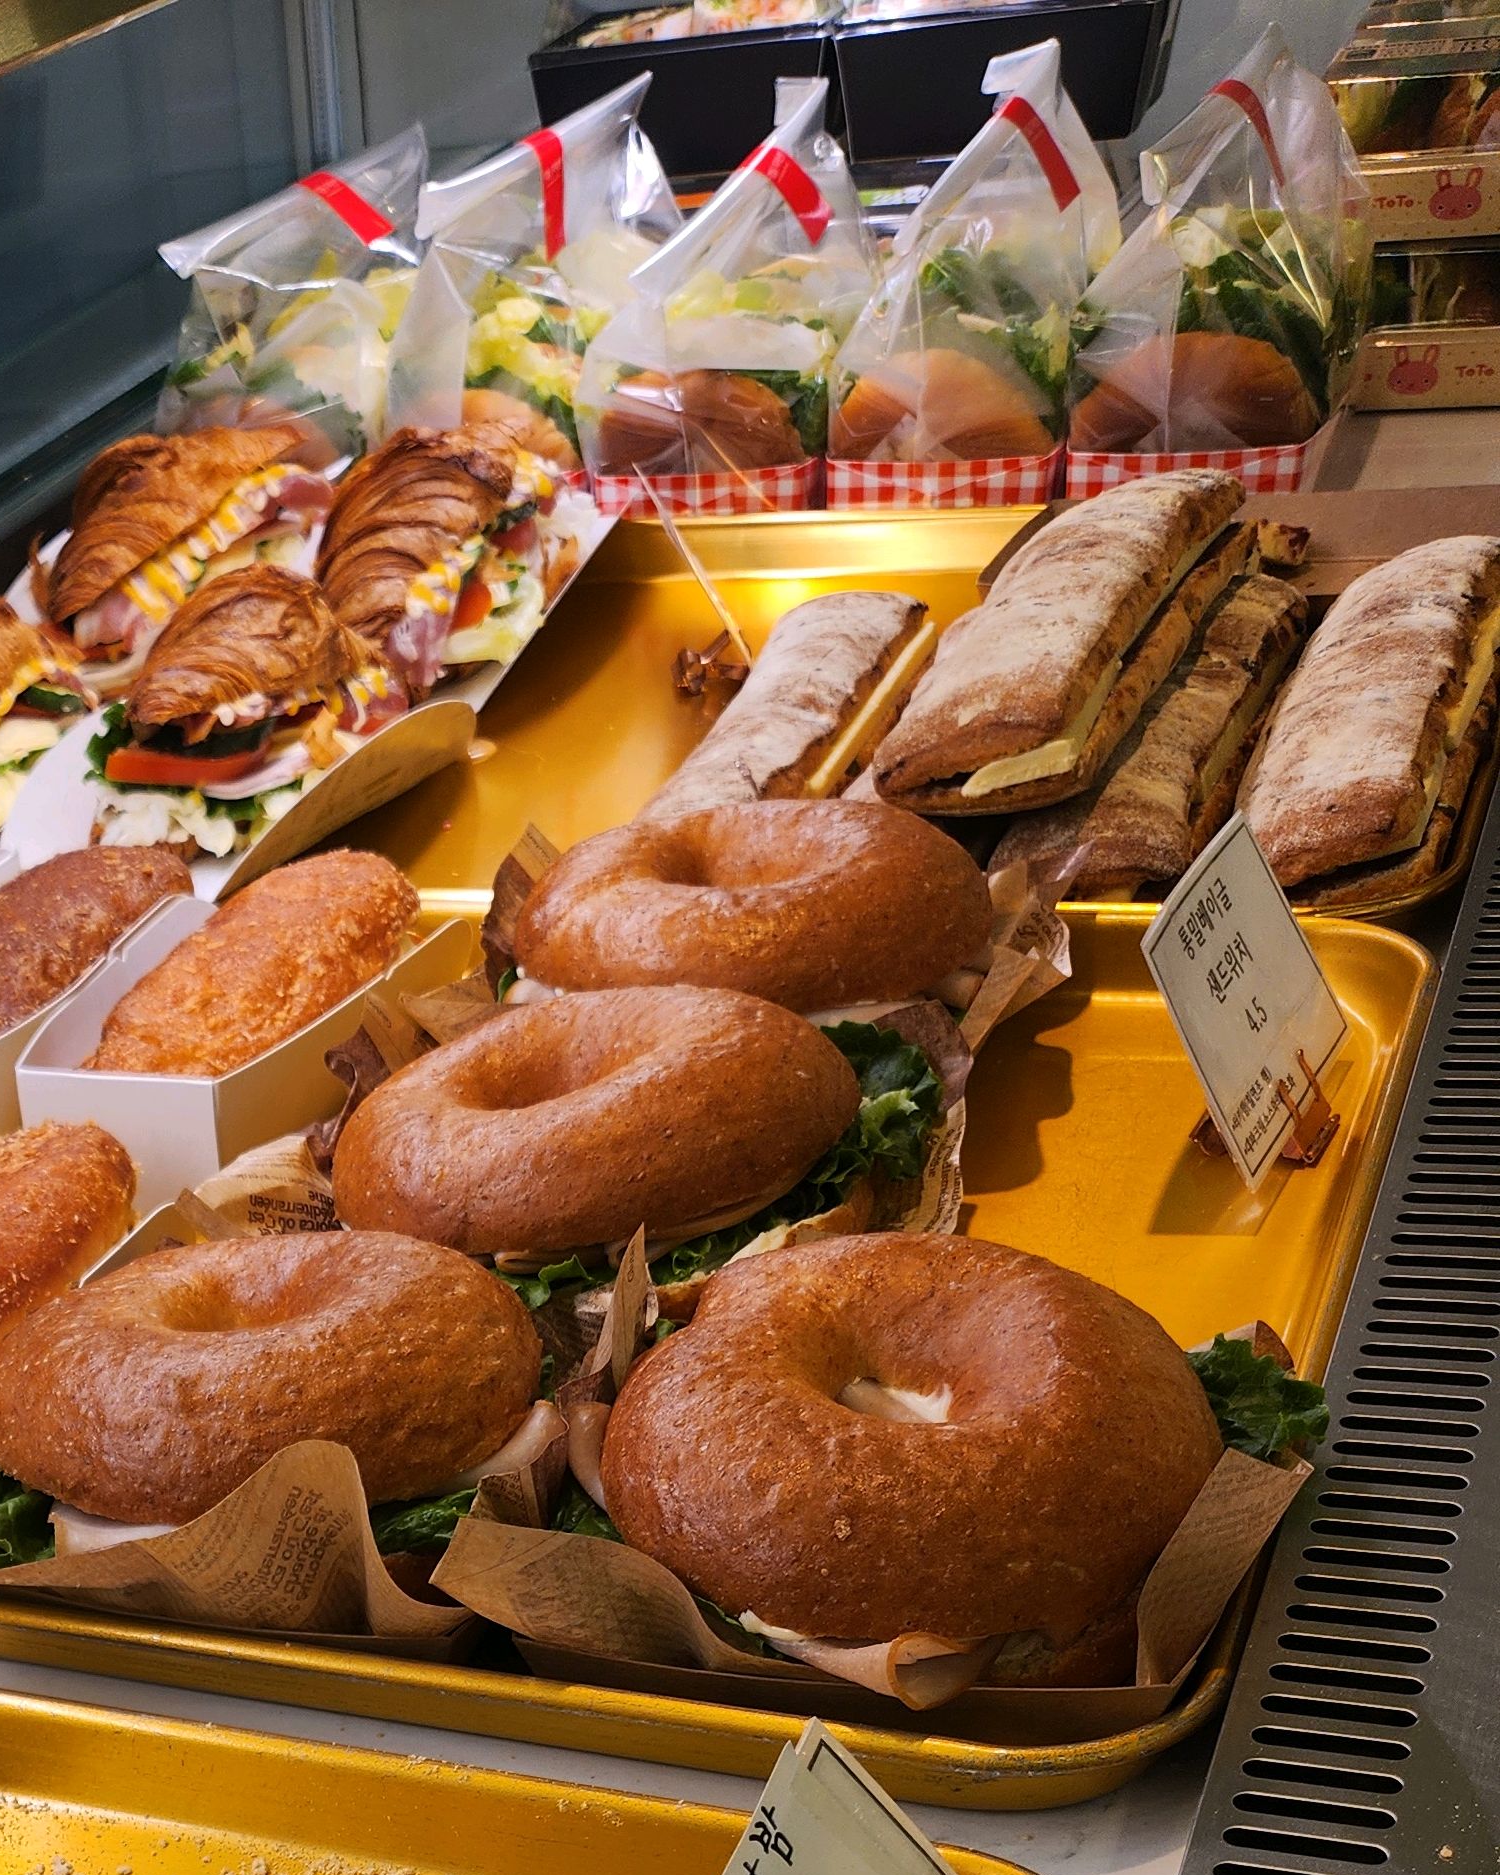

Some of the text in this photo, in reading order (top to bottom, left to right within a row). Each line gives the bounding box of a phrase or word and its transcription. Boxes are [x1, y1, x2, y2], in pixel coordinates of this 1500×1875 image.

[1177, 877, 1233, 960] 통밀베이글
[1206, 931, 1254, 1004] 샌드위치
[1244, 997, 1268, 1033] 4.5
